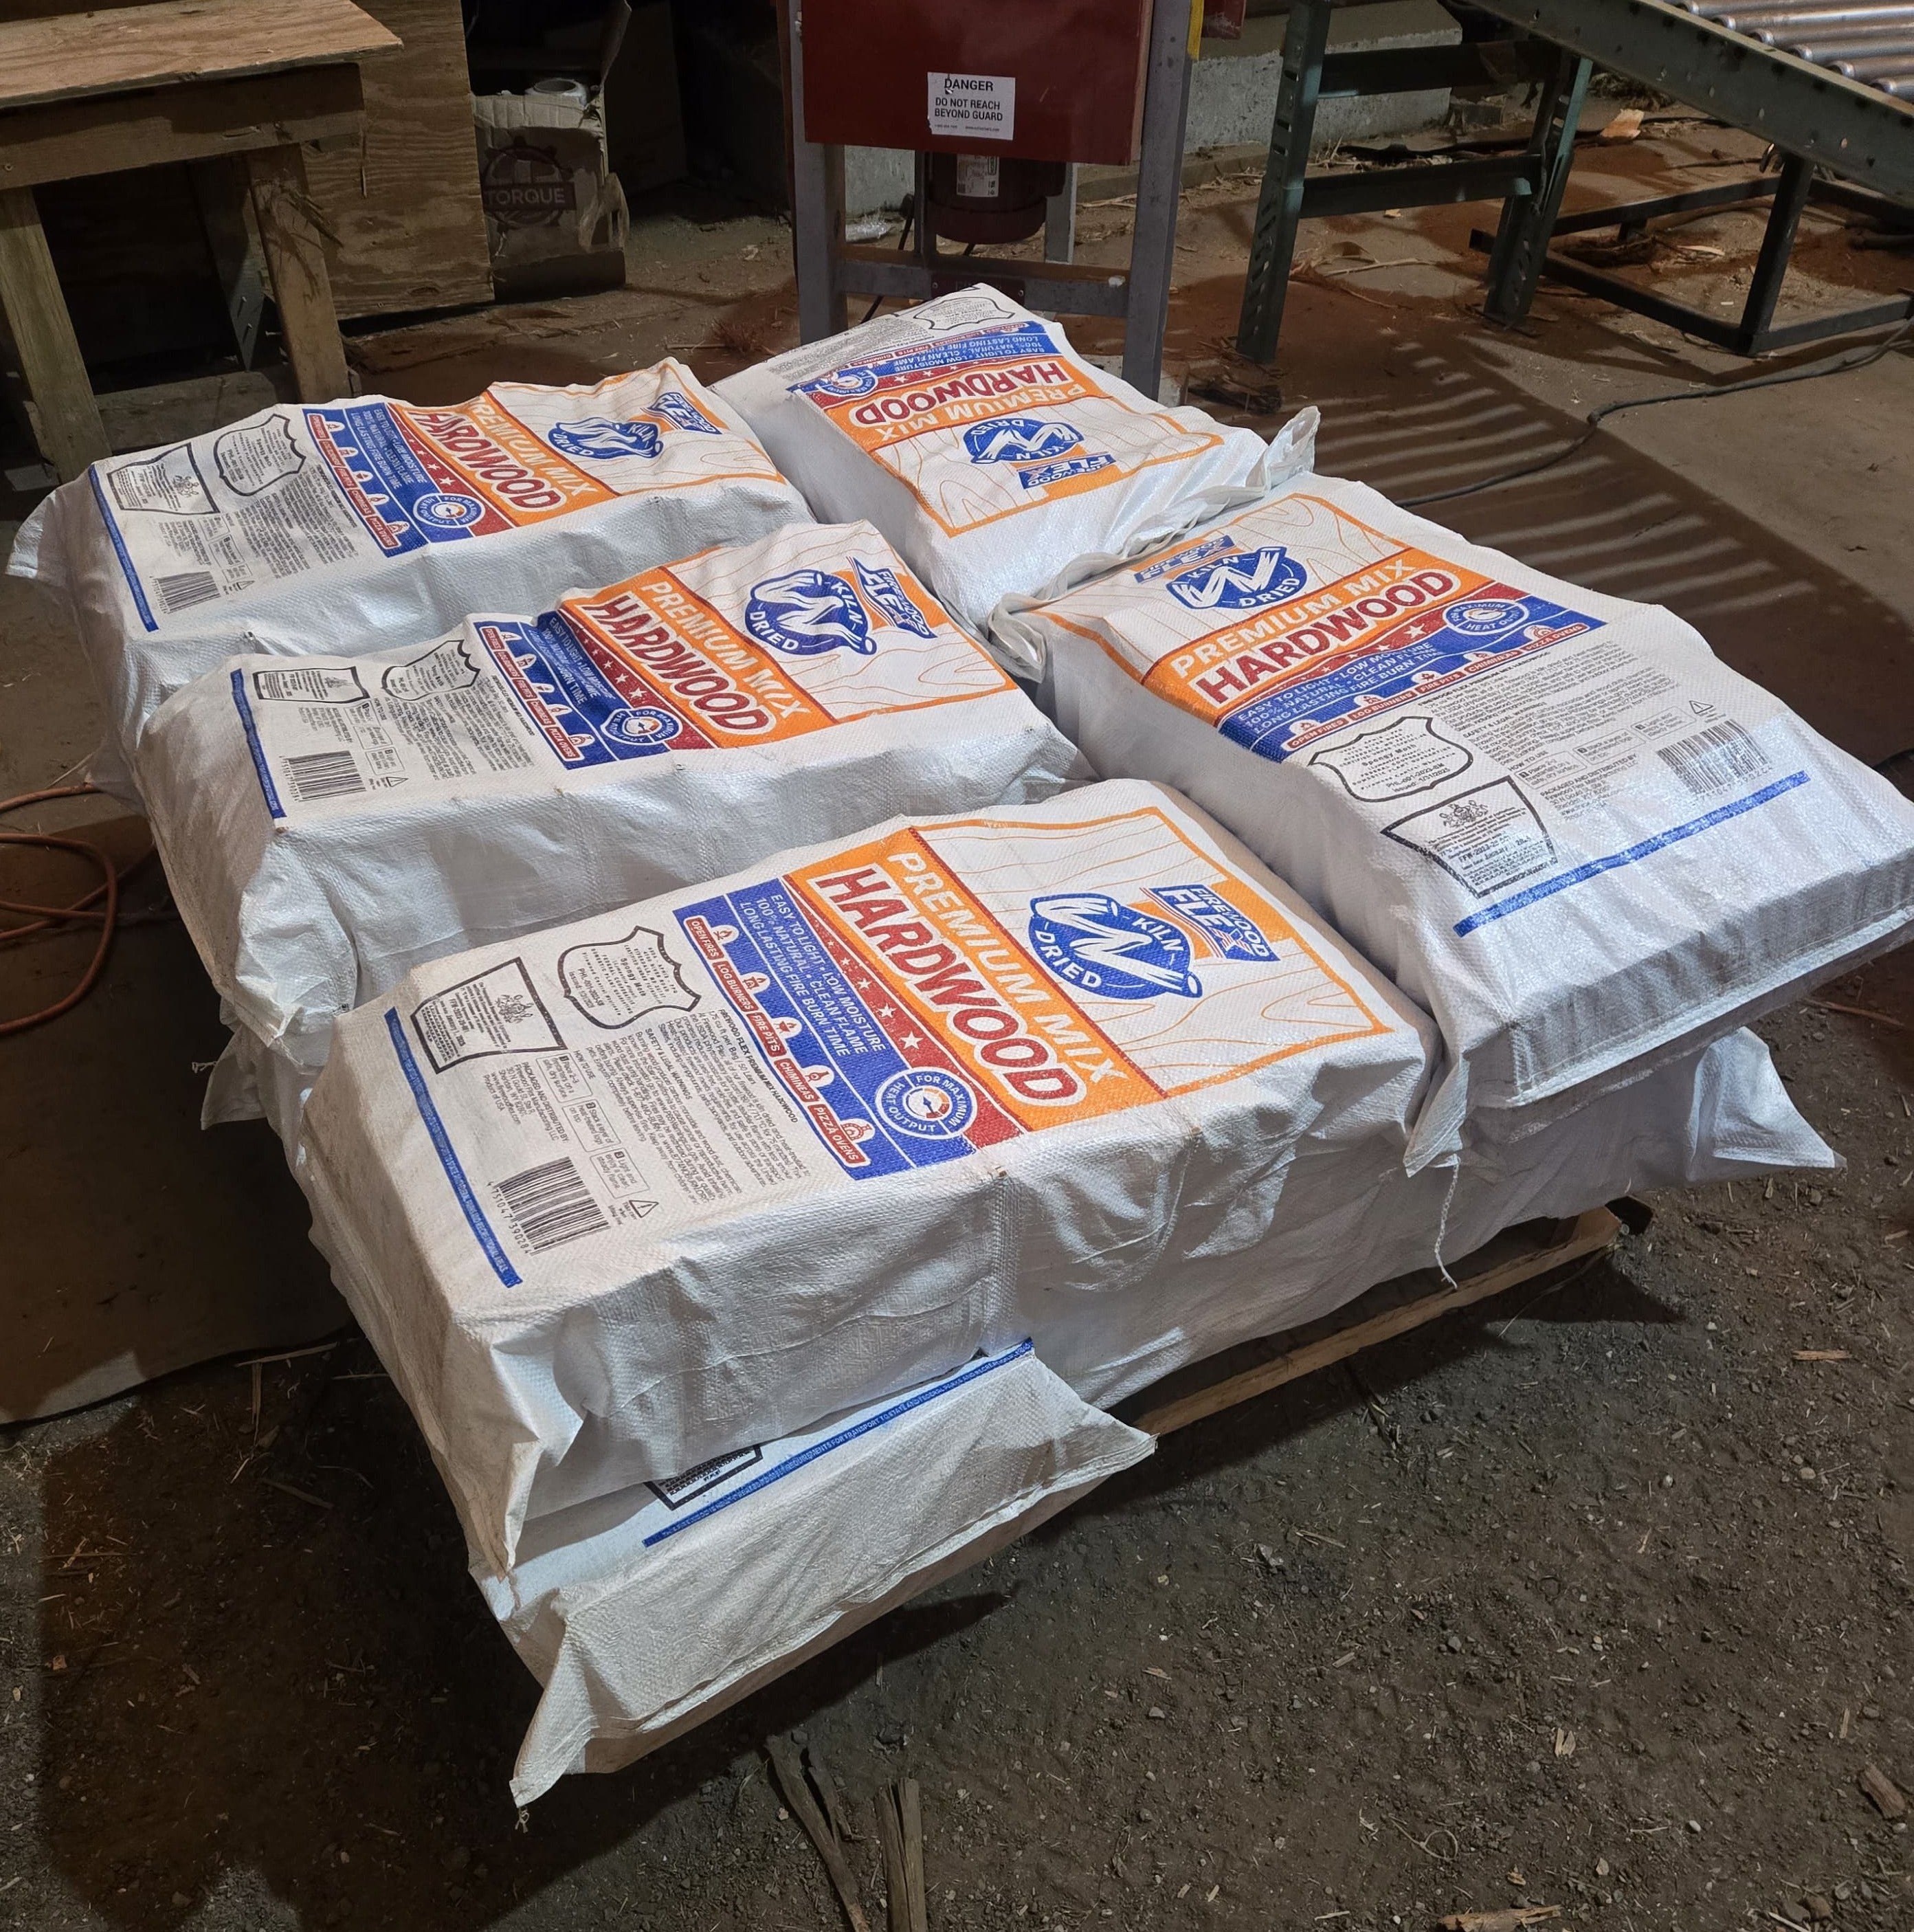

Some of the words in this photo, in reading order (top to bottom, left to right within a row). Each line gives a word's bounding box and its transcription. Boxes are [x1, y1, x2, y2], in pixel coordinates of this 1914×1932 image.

[944, 78, 993, 91] DANGER
[935, 109, 970, 118] BEYOND
[972, 111, 1003, 121] GUARD
[936, 98, 947, 106] DO
[950, 99, 968, 107] NOT
[970, 100, 1000, 109] REACH
[485, 188, 565, 203] TORQUE
[895, 359, 941, 371] MOISTURE
[927, 350, 959, 359] CLEAN
[850, 362, 1068, 425] HARDWOOD
[943, 383, 1085, 420] PREMIUM
[875, 414, 939, 441] MIX
[970, 419, 1024, 435] DRIED
[348, 412, 364, 426] LONG
[356, 427, 377, 448] LASTING
[369, 449, 383, 460] FIRE
[376, 460, 394, 475] BURN
[555, 434, 592, 455] DRIED
[1016, 445, 1064, 459] KILN
[394, 467, 414, 483] FLAME
[399, 454, 427, 483] MOISTURE
[539, 467, 598, 496] MIX
[1025, 456, 1108, 480] FLEX
[1188, 556, 1239, 579] KILN
[831, 581, 862, 623] KILN
[1240, 578, 1300, 606] DRIED
[1170, 591, 1342, 678] PREMIUM
[1344, 559, 1417, 596] MIX
[1454, 603, 1505, 611] MAXIMUM
[548, 617, 567, 634] EASY
[750, 611, 798, 649] DRIED
[1194, 568, 1458, 703] HARDWOOD
[1524, 636, 1553, 650] PIZZA
[1551, 625, 1583, 639] OVENS
[561, 637, 574, 646] TO
[566, 645, 583, 662] LIGHT
[640, 581, 758, 670] PREMIUM
[743, 668, 810, 718] MIX
[578, 665, 593, 676] LOW
[582, 595, 770, 732] HARDWOOD
[568, 684, 588, 704] TIME
[1237, 700, 1272, 720] EASY
[1275, 691, 1295, 702] TO
[1294, 678, 1332, 694] LIGHT
[1338, 660, 1368, 677] LOW
[1245, 706, 1283, 726] 100%
[1283, 682, 1345, 708] NATURAL
[1352, 658, 1397, 681] CLEAN
[1253, 711, 1292, 733] LONG
[1293, 687, 1348, 713] LASTING
[1350, 676, 1378, 691] FIRE
[1378, 660, 1415, 678] BURN
[1418, 681, 1440, 691] FIRE
[1439, 673, 1461, 683] PITS
[1352, 708, 1373, 719] LOG
[1371, 692, 1414, 711] BURNERS
[548, 727, 564, 742] PIZZA
[654, 715, 674, 737] MAXIMUM
[1290, 731, 1319, 746] OPEN
[1317, 719, 1344, 733] FIRES
[1361, 752, 1394, 766] Spongy
[1395, 743, 1416, 753] Moth
[1130, 918, 1185, 951] KILN
[1164, 891, 1252, 956] FLEX
[1194, 889, 1271, 957] FIREWOOD
[691, 921, 708, 940] OPEN
[701, 939, 720, 957] FIRES
[769, 894, 796, 920] EASY
[787, 922, 806, 936] TO
[797, 936, 826, 965] LIGHT
[820, 972, 847, 996] LOW
[838, 997, 887, 1052] MOISTURE
[886, 853, 1049, 1004] PREMIUM
[1032, 1013, 1128, 1083] MIX
[1034, 930, 1106, 987] DRIED
[619, 957, 637, 981] Spongy
[634, 981, 647, 997] Moth
[716, 964, 732, 979] LOG
[726, 979, 753, 1010] BURNERS
[738, 902, 765, 929] LONG
[755, 930, 794, 973] LASTING
[785, 974, 810, 996] FIRE
[801, 998, 830, 1025] BURN
[822, 1028, 852, 1057] TIME
[753, 898, 781, 925] 100%
[771, 926, 812, 973] NATURAL
[807, 980, 843, 1017] CLEAN
[833, 1017, 869, 1054] FLAME
[814, 868, 1079, 1102] HARDWOOD
[735, 1037, 750, 1055] FLEX
[751, 1015, 768, 1031] FIRE
[761, 1032, 781, 1052] PITS
[645, 1028, 662, 1052] SAFETY
[660, 1055, 674, 1071] LEGAL
[573, 1050, 586, 1062] HOW
[584, 1068, 596, 1079] USE
[779, 1061, 814, 1100] CHIMINEAS
[886, 1082, 904, 1104] HEAT
[521, 1061, 541, 1090] PACKAGED
[536, 1090, 547, 1101] AND
[542, 1101, 565, 1134] DISTRIBUTED
[942, 1080, 966, 1126] MAXIMUM
[813, 1107, 838, 1134] PIZZA
[832, 1134, 859, 1160] OVENS
[888, 1107, 936, 1131] OUTPUT
